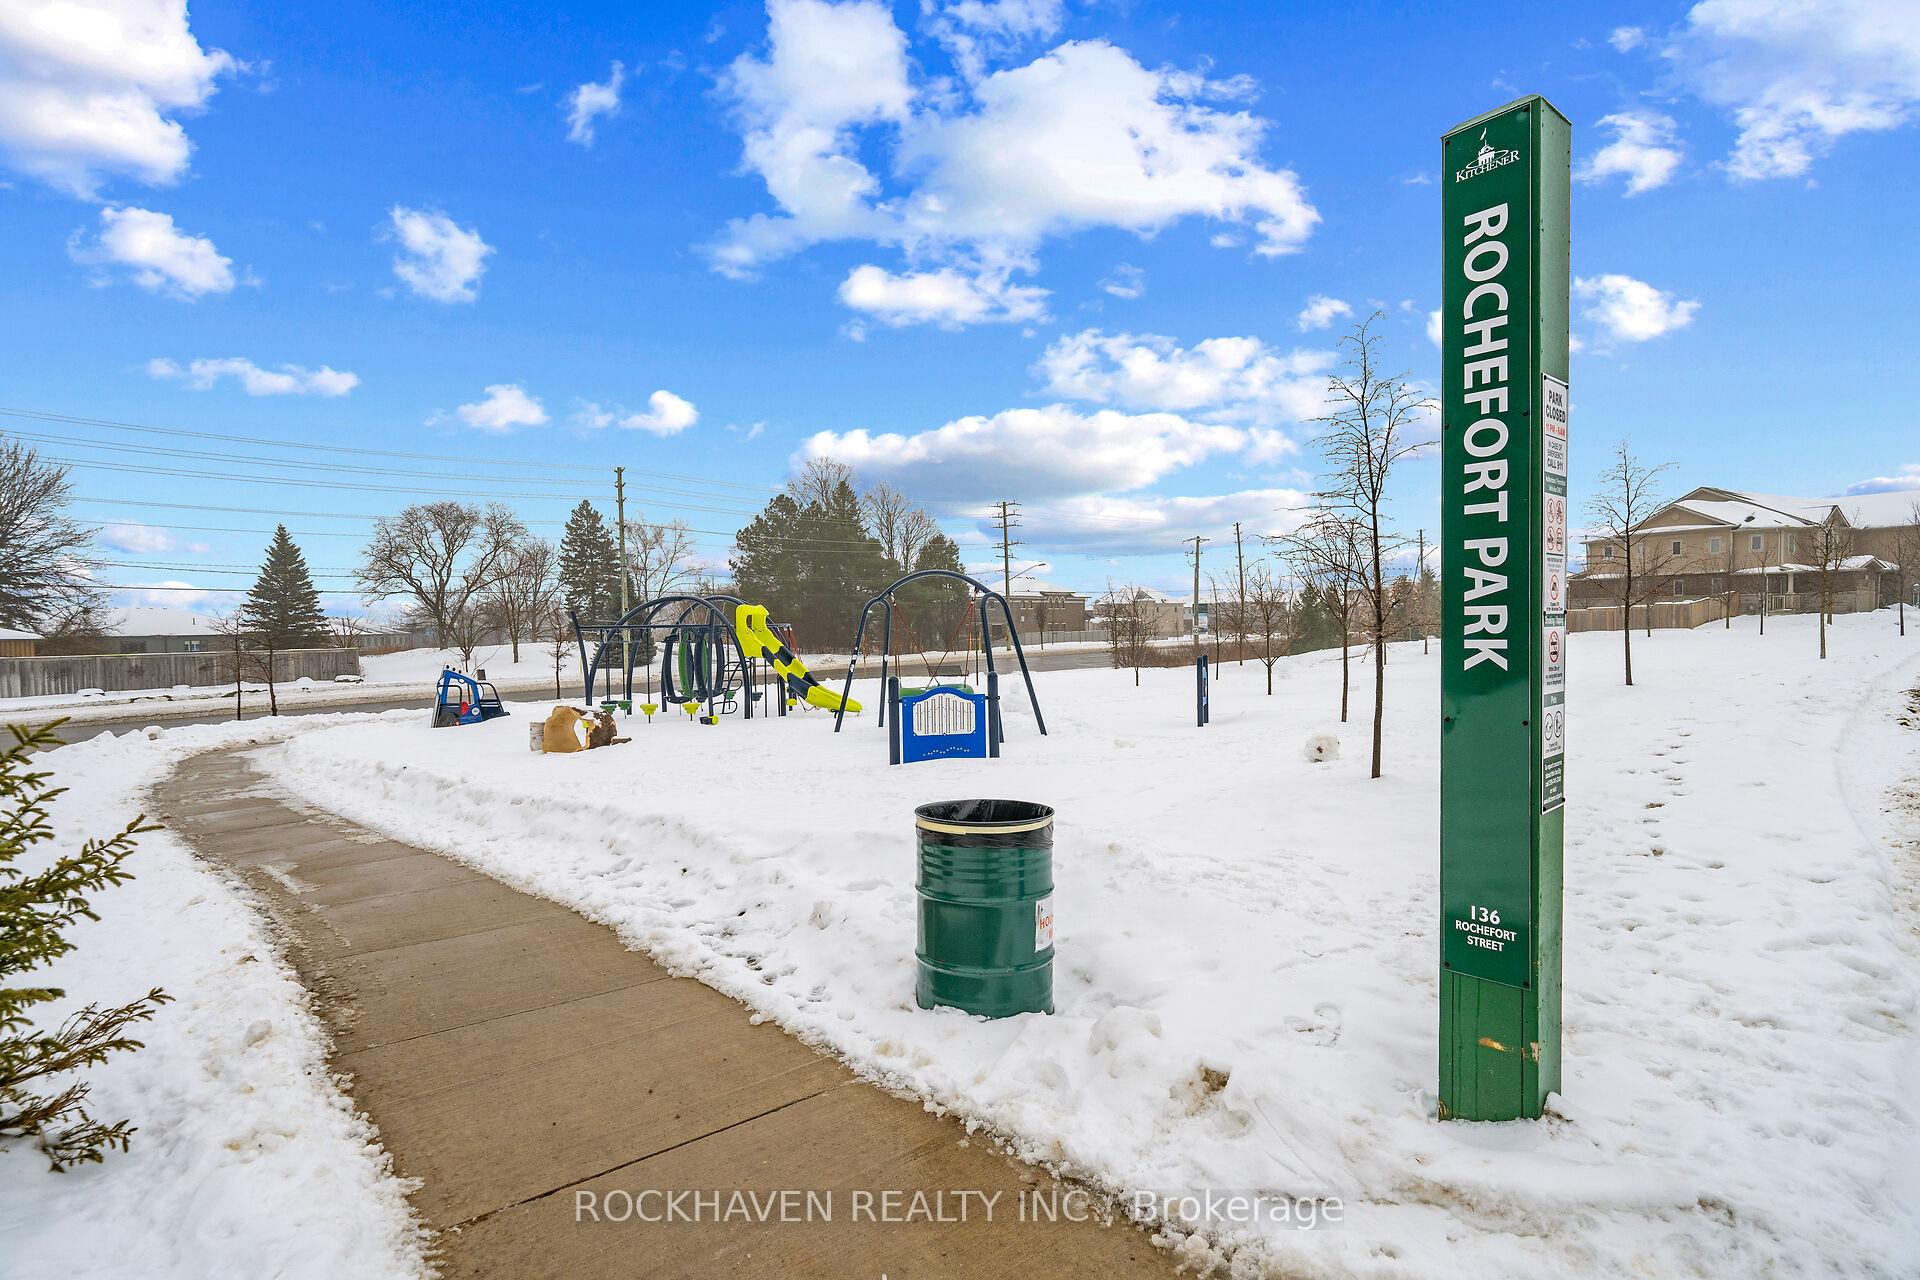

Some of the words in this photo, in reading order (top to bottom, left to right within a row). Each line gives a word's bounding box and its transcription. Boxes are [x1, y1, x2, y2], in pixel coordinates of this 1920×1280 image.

[1456, 150, 1520, 183] KITCHENER
[1463, 202, 1509, 522] ROCHEFORT
[1549, 390, 1563, 407] PARK
[1546, 404, 1566, 423] CLOSED
[1547, 458, 1556, 469] CALL
[1463, 536, 1509, 672] PARK
[1471, 905, 1501, 925] 136
[1455, 919, 1517, 942] ROCHEFORT
[1467, 935, 1504, 952] STREET
